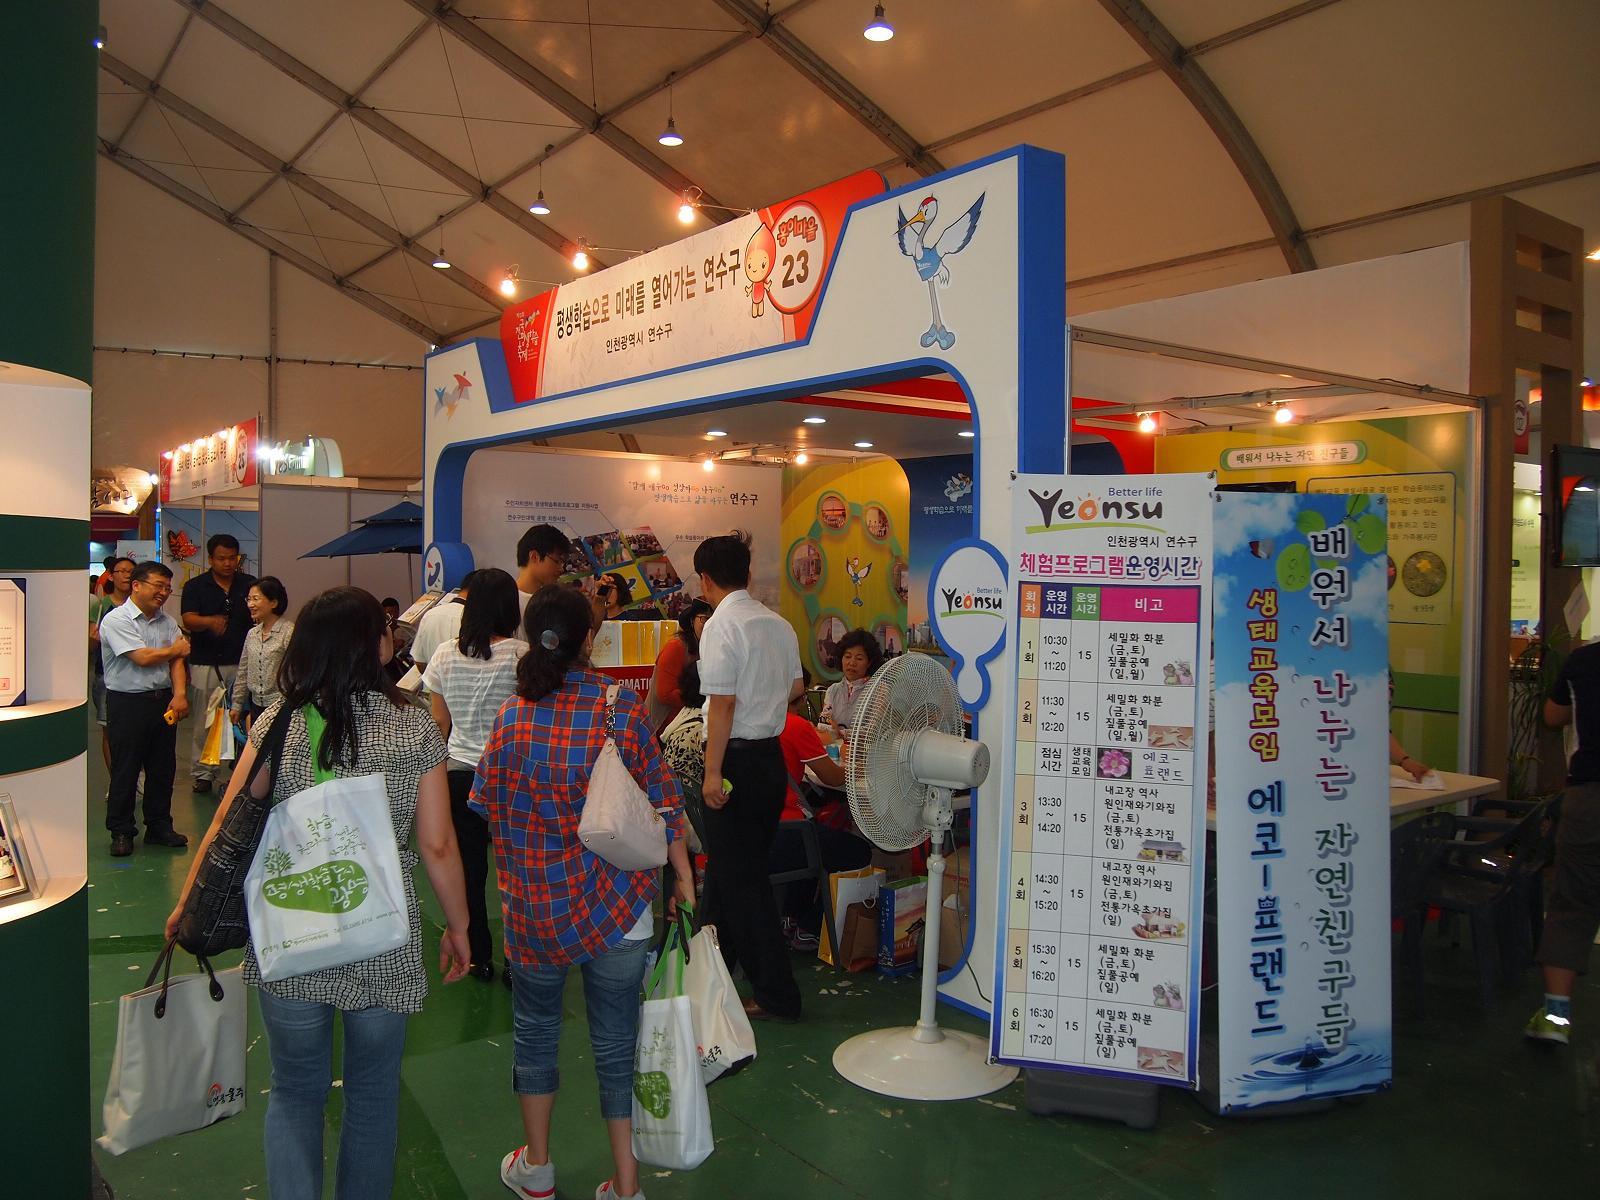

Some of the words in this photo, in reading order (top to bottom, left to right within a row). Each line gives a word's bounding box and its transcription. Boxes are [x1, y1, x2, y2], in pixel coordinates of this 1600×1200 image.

[782, 250, 808, 288] 23
[556, 294, 610, 340] 평생학습으로
[615, 279, 646, 320] 미래를
[652, 265, 697, 311] 열어가는
[703, 248, 741, 294] 연수구
[606, 332, 645, 354] 인천광역시
[648, 322, 673, 344] 연수구
[1266, 452, 1293, 462] 나누는
[1108, 487, 1143, 497] Better
[1145, 487, 1163, 497] life
[730, 492, 759, 506] 연수구
[1028, 489, 1163, 528] Yeonsu
[1107, 535, 1160, 548] 인천광역시
[1165, 536, 1198, 549] 연수구
[976, 587, 993, 595] Better
[993, 587, 1003, 595] life
[1309, 526, 1347, 645] 배워서
[941, 587, 1003, 614] Yeonsu
[1045, 590, 1068, 602] 운영
[1075, 592, 1097, 603] 운영
[1045, 603, 1068, 615] 시간
[1075, 604, 1097, 614] 시간
[1135, 598, 1164, 612] 비고
[1043, 635, 1068, 645] 10:30
[1108, 632, 1139, 643] 세밀화
[1143, 633, 1165, 645] 화분
[1078, 651, 1092, 660] 15
[1044, 661, 1067, 671] 11:20
[1248, 588, 1279, 762] 생태교육모임
[618, 678, 653, 691] RMATI
[1042, 696, 1065, 706] 11:30
[1106, 693, 1138, 705] 세밀화
[1142, 695, 1163, 706] 화분
[1076, 711, 1090, 721] 15
[1041, 722, 1065, 732] 12:20
[1313, 672, 1351, 793] 나누는
[1041, 747, 1062, 759] 점심
[1040, 761, 1062, 772] 시간
[1105, 785, 1135, 799] 내고장
[1139, 787, 1159, 799] 역사
[1038, 797, 1062, 807] 13:30
[1104, 799, 1176, 814] 원인재와기와집
[1073, 813, 1087, 823] 15
[1037, 823, 1062, 833] 14:20
[1105, 838, 1125, 850] (일)
[1102, 861, 1132, 875] 내고장
[1136, 863, 1156, 876] 역사
[1035, 875, 1059, 885] 14:30
[1101, 874, 1173, 892] 원인재와기와집
[1070, 889, 1084, 899] 15
[1034, 900, 1058, 911] 15:20
[1102, 914, 1122, 927] (일)
[1032, 944, 1056, 955] 15:30
[1098, 944, 1130, 957] 세밀화
[1134, 947, 1155, 961] 화분
[1067, 958, 1081, 968] 15
[1031, 971, 1056, 982] 16:20
[1030, 1008, 1054, 1019] 16:30
[1095, 1008, 1127, 1021] 세밀화
[1131, 1011, 1153, 1026] 화분
[1065, 1021, 1079, 1031] 15
[1029, 1034, 1053, 1046] 17:20
